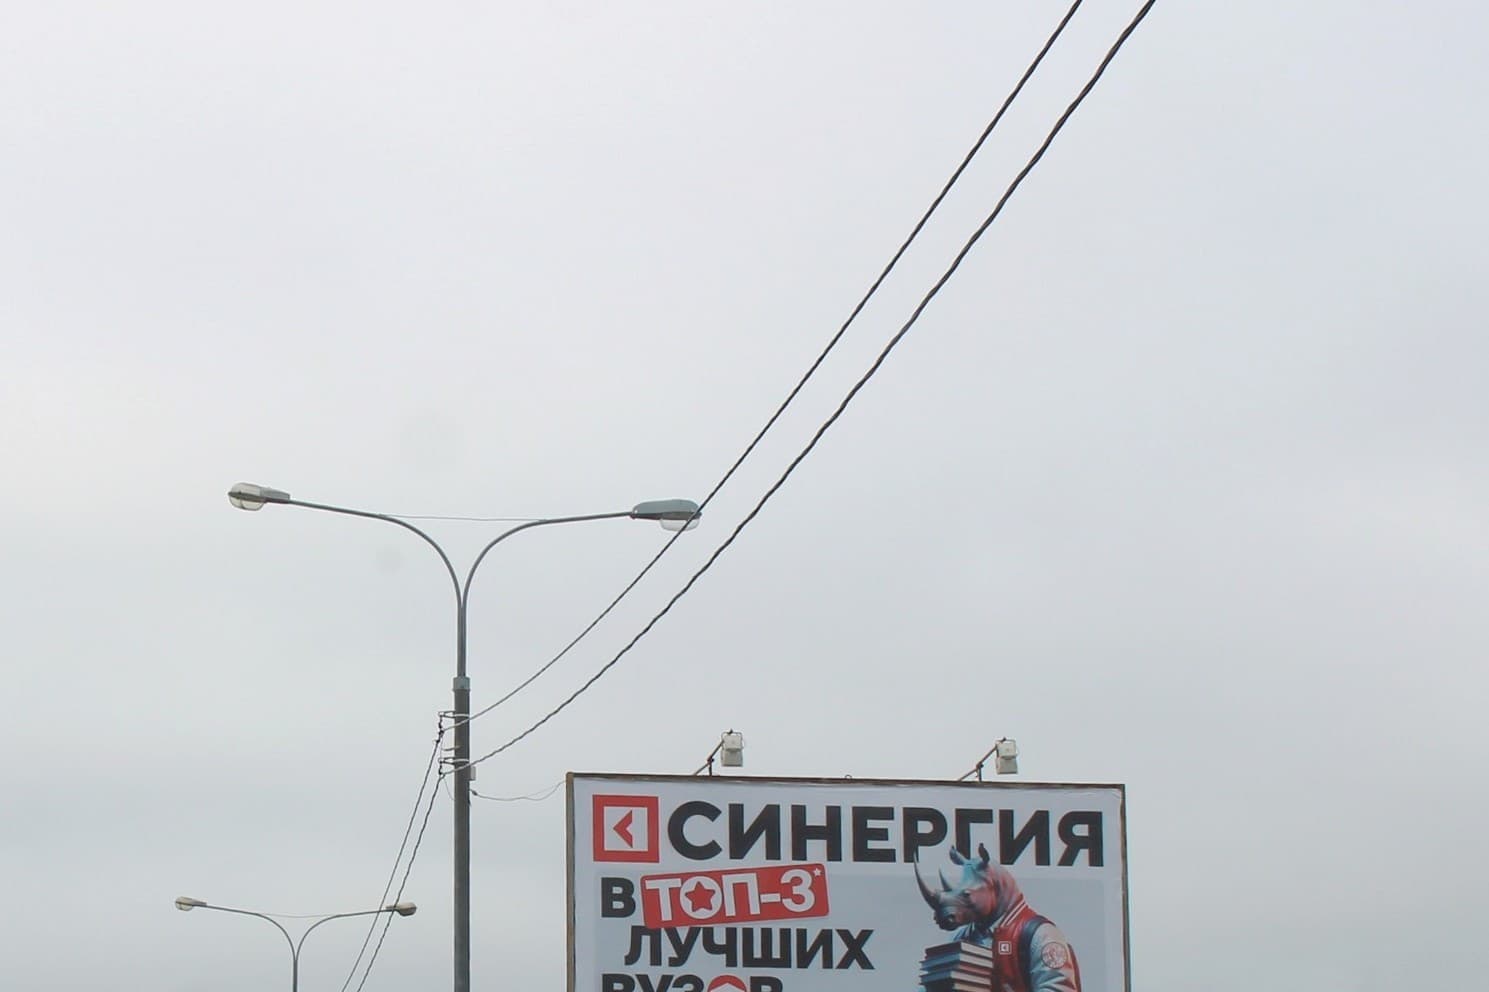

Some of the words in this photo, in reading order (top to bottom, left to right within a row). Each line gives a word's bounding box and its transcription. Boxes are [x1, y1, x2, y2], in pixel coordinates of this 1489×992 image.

[667, 800, 1104, 868] СИНЕРГИЯ
[601, 877, 636, 918] В
[624, 926, 875, 970] ЛУЧШИХ
